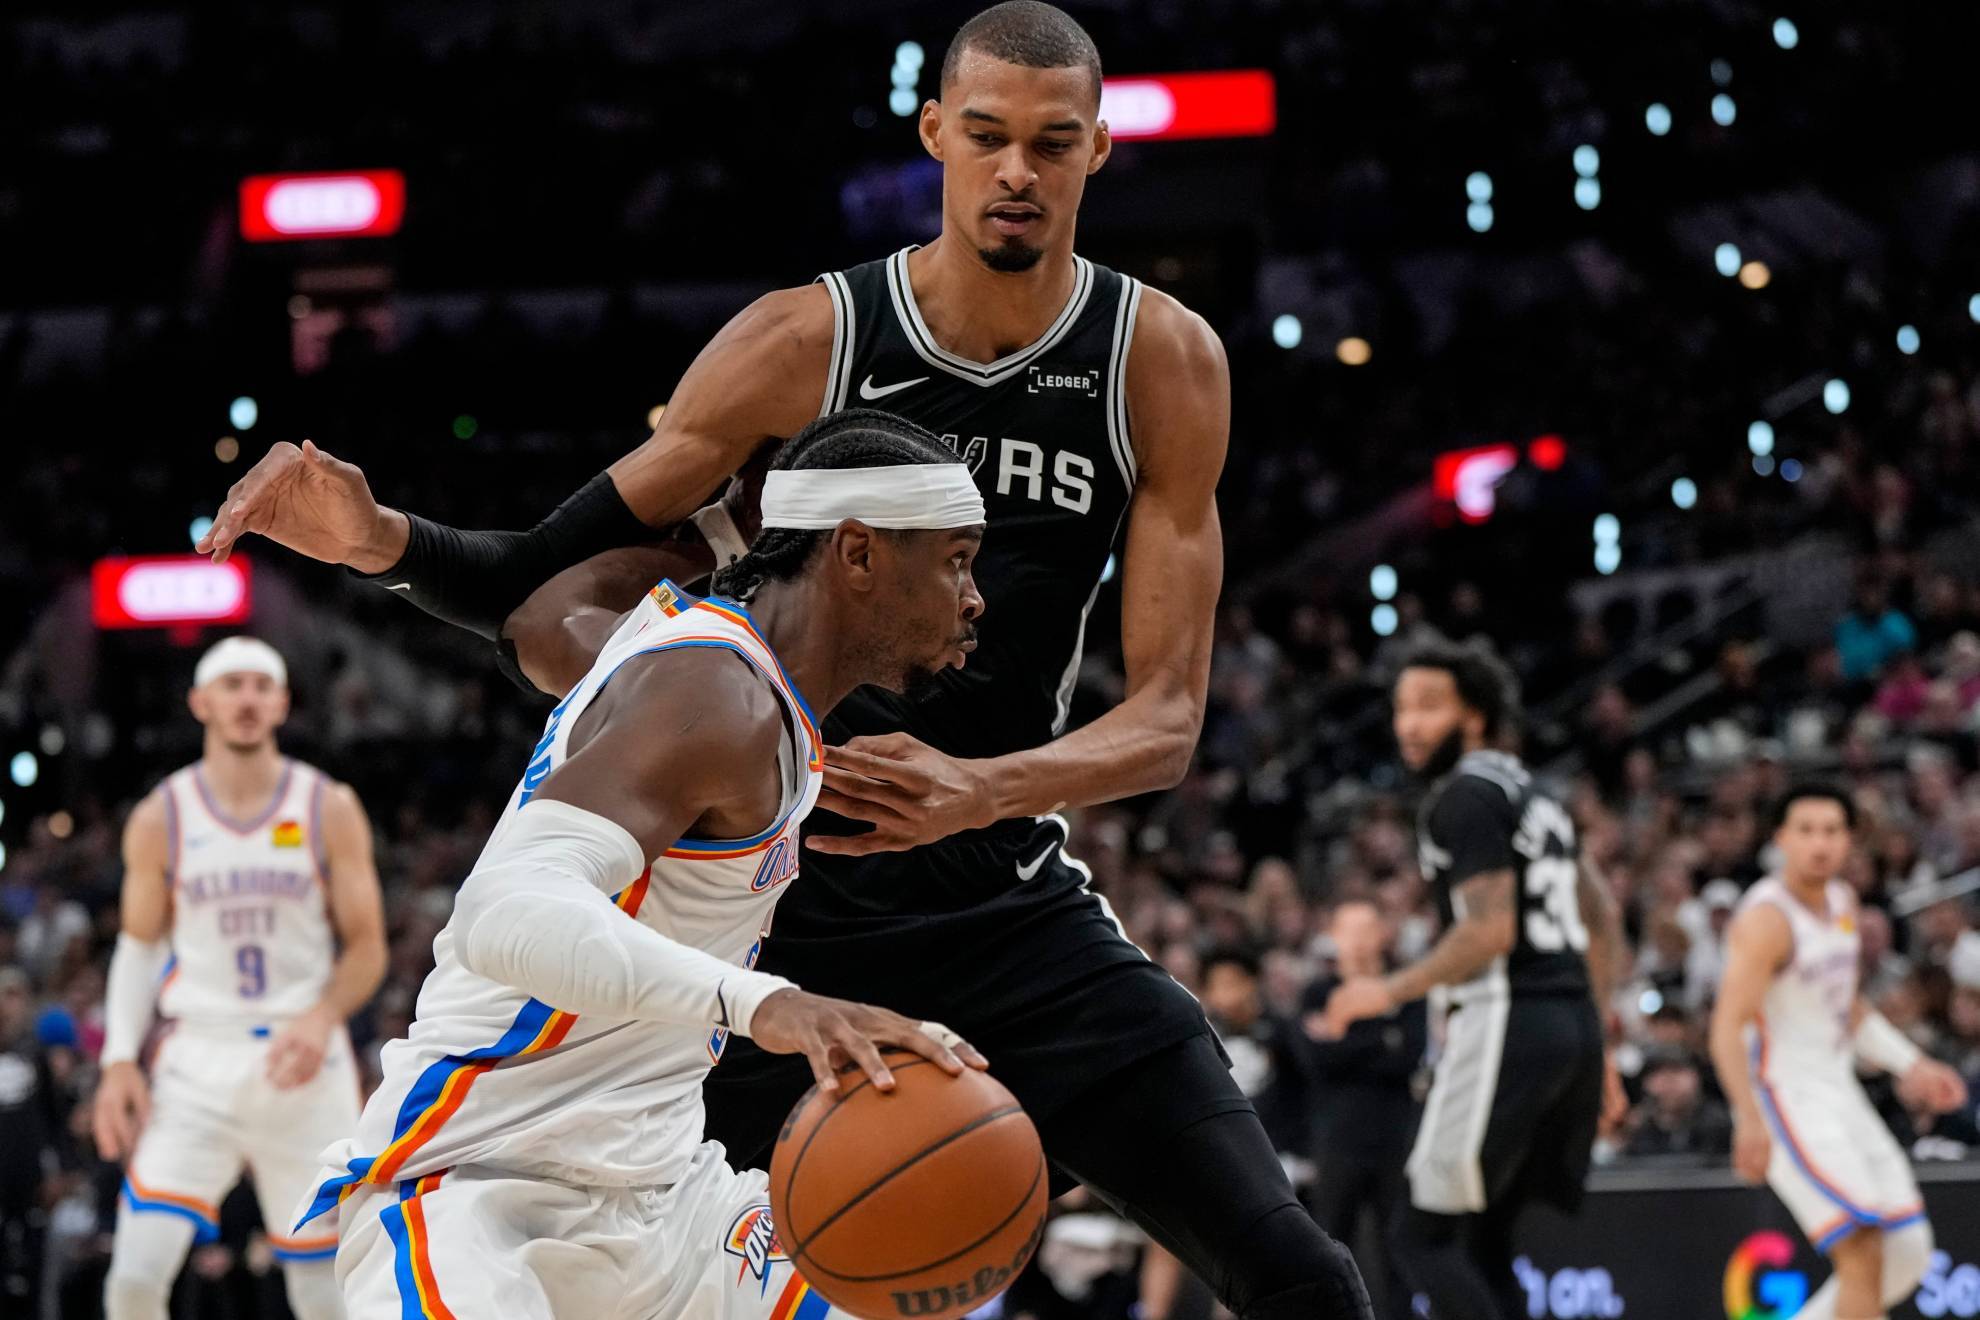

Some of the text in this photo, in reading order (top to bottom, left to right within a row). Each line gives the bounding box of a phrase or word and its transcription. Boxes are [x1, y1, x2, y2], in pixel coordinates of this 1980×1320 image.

[1037, 374, 1091, 390] LEDGER
[941, 434, 1095, 515] RS
[237, 944, 267, 998] 9
[744, 1211, 775, 1280] OKC
